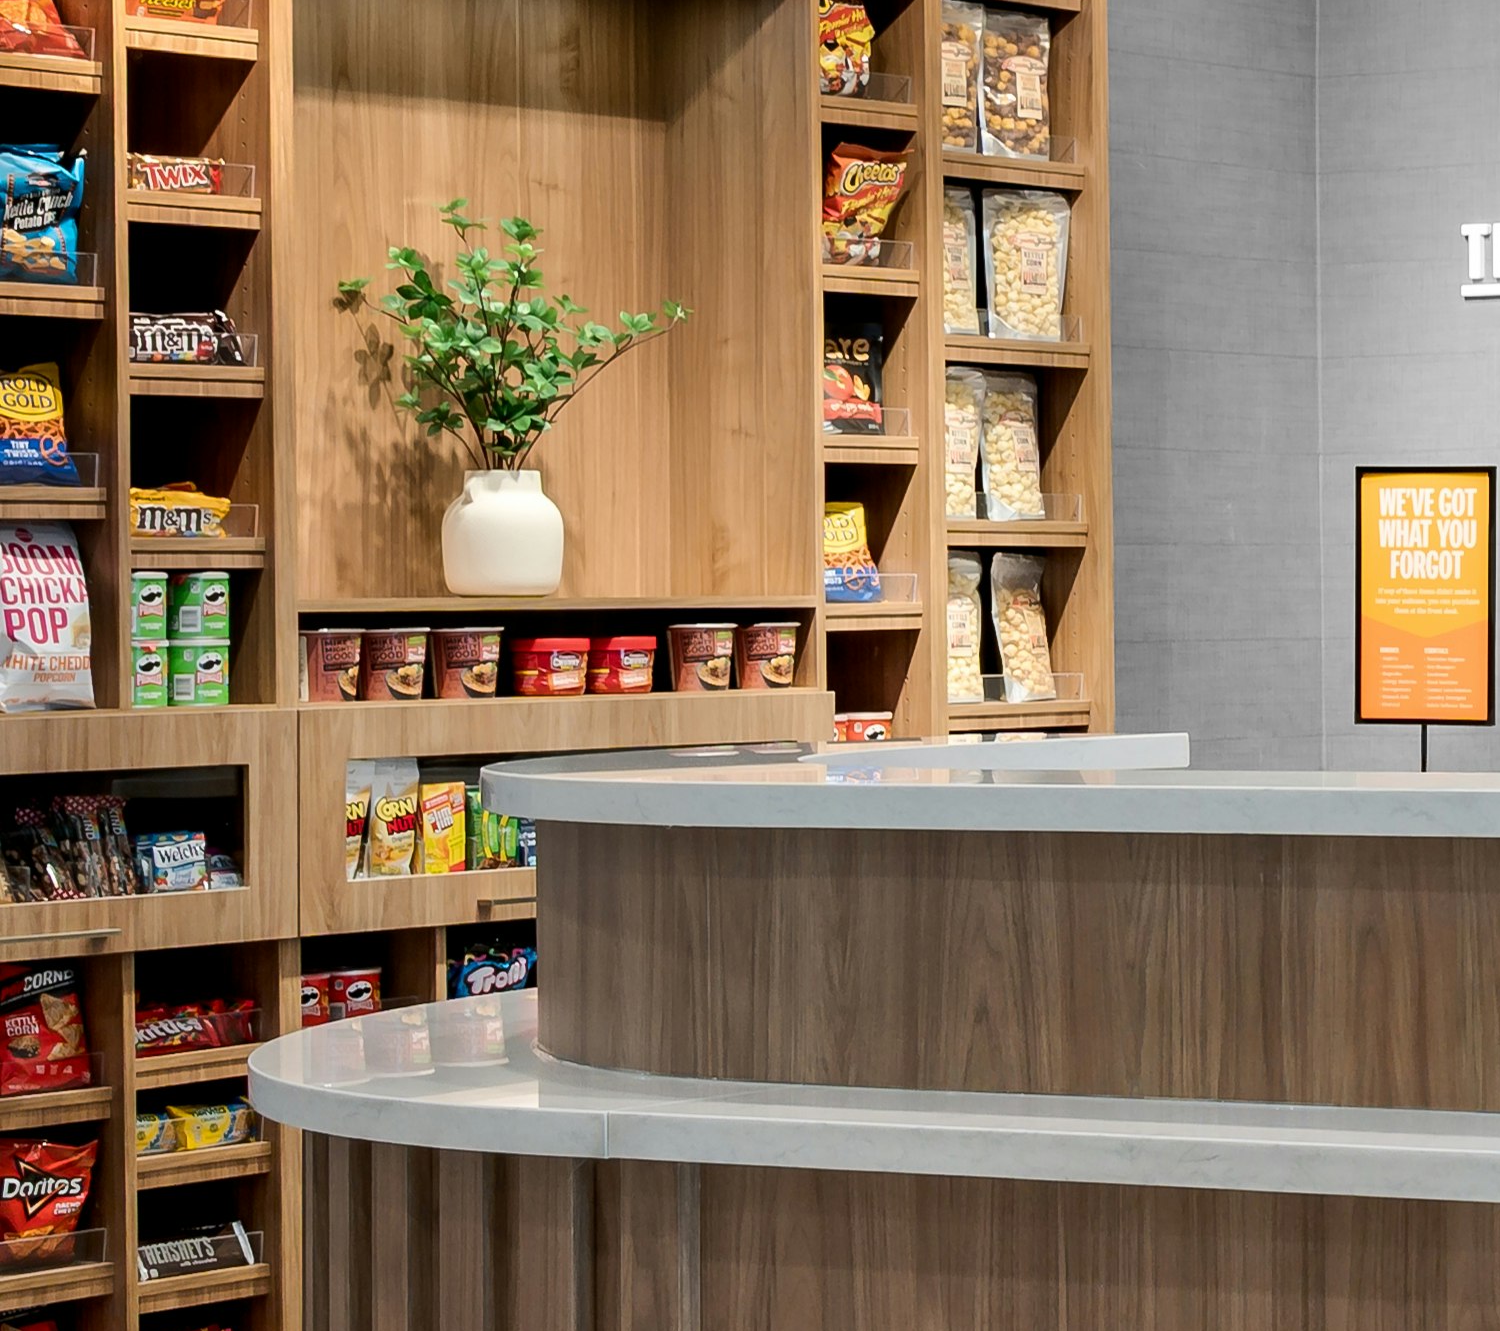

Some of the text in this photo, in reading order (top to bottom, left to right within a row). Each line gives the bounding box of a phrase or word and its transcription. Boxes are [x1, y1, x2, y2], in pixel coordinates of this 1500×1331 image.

[138, 162, 208, 190] TWIX
[845, 163, 898, 192] Cheetos
[14, 215, 43, 230] Potato
[1, 377, 48, 393] ROLD
[3, 394, 53, 409] GOLD
[1379, 488, 1478, 517] WE'VE GOT
[1378, 519, 1478, 548] WHAT YOU
[1390, 550, 1465, 580] FORGOT
[4, 608, 68, 644] POP
[372, 651, 403, 662] GOOD
[448, 650, 478, 659] GOOD
[33, 672, 76, 683] POPCORN
[376, 797, 415, 822] CORN
[5, 1015, 37, 1029] KETTLE
[6, 1025, 40, 1037] CORN
[2, 1177, 83, 1199] Doritos
[144, 1236, 215, 1266] HERSHEY'S
